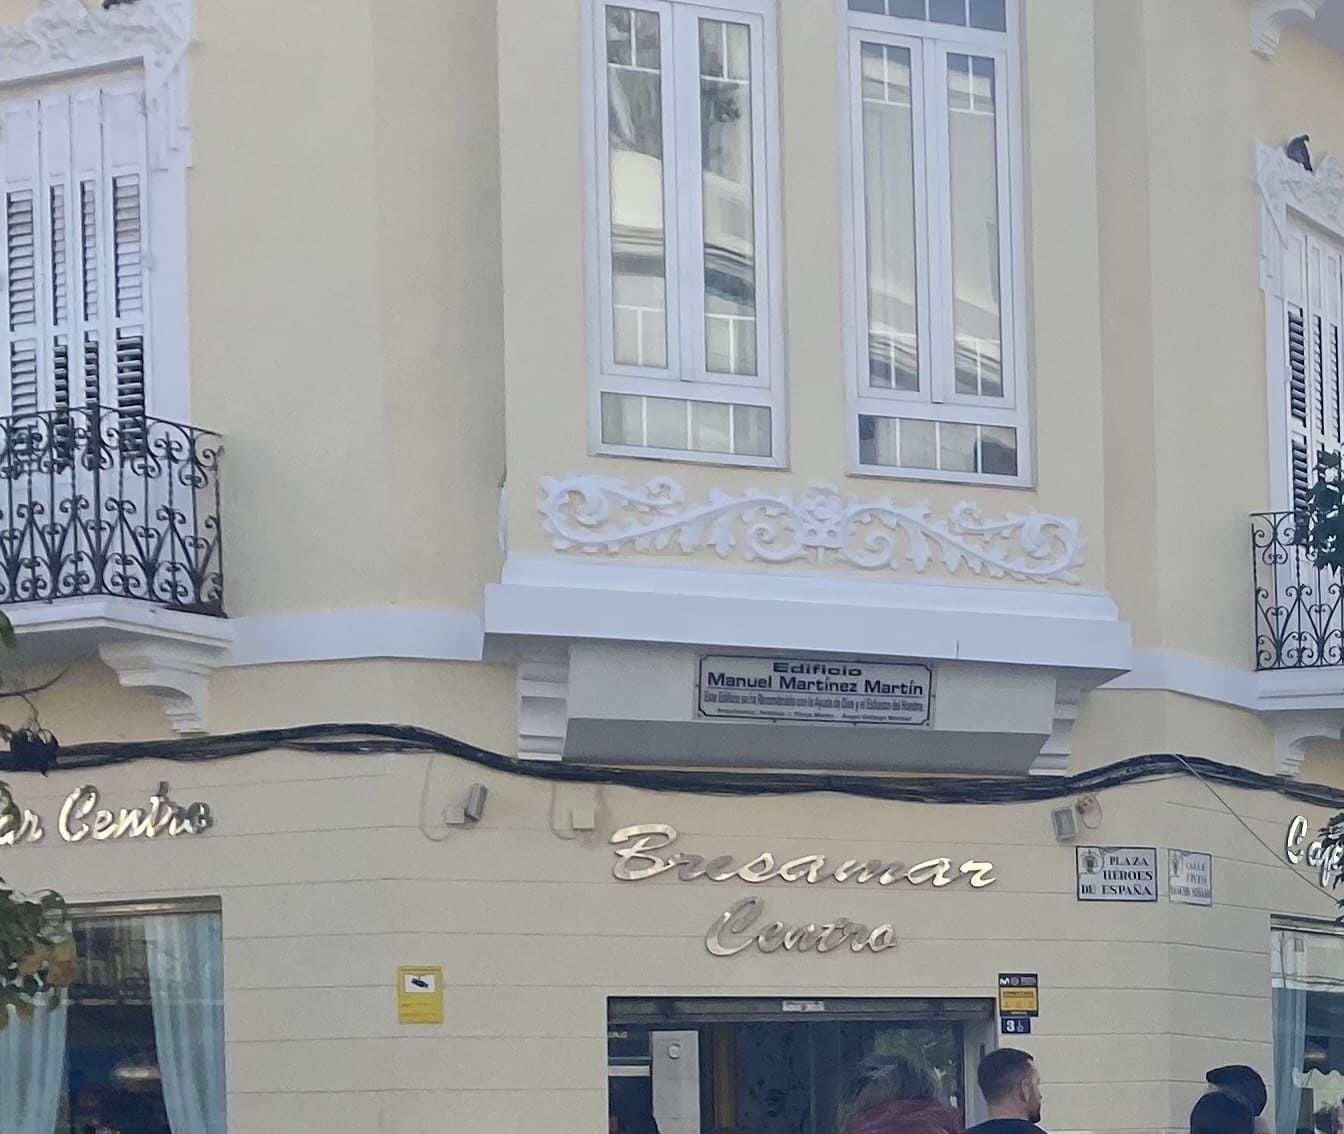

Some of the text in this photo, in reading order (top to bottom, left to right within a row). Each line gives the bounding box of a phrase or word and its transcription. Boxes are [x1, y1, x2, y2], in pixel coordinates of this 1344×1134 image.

[773, 662, 863, 677] Edificio
[707, 671, 923, 696] Manuel Martínez Martín
[59, 780, 213, 843] Centro
[608, 823, 998, 888] Bresamar
[1109, 855, 1150, 867] PLAZA
[1103, 869, 1154, 881] HEROES
[1081, 884, 1096, 895] DE
[1101, 883, 1153, 896] ESPAÑA
[704, 896, 898, 956] Centro
[1006, 1019, 1015, 1033] 3
